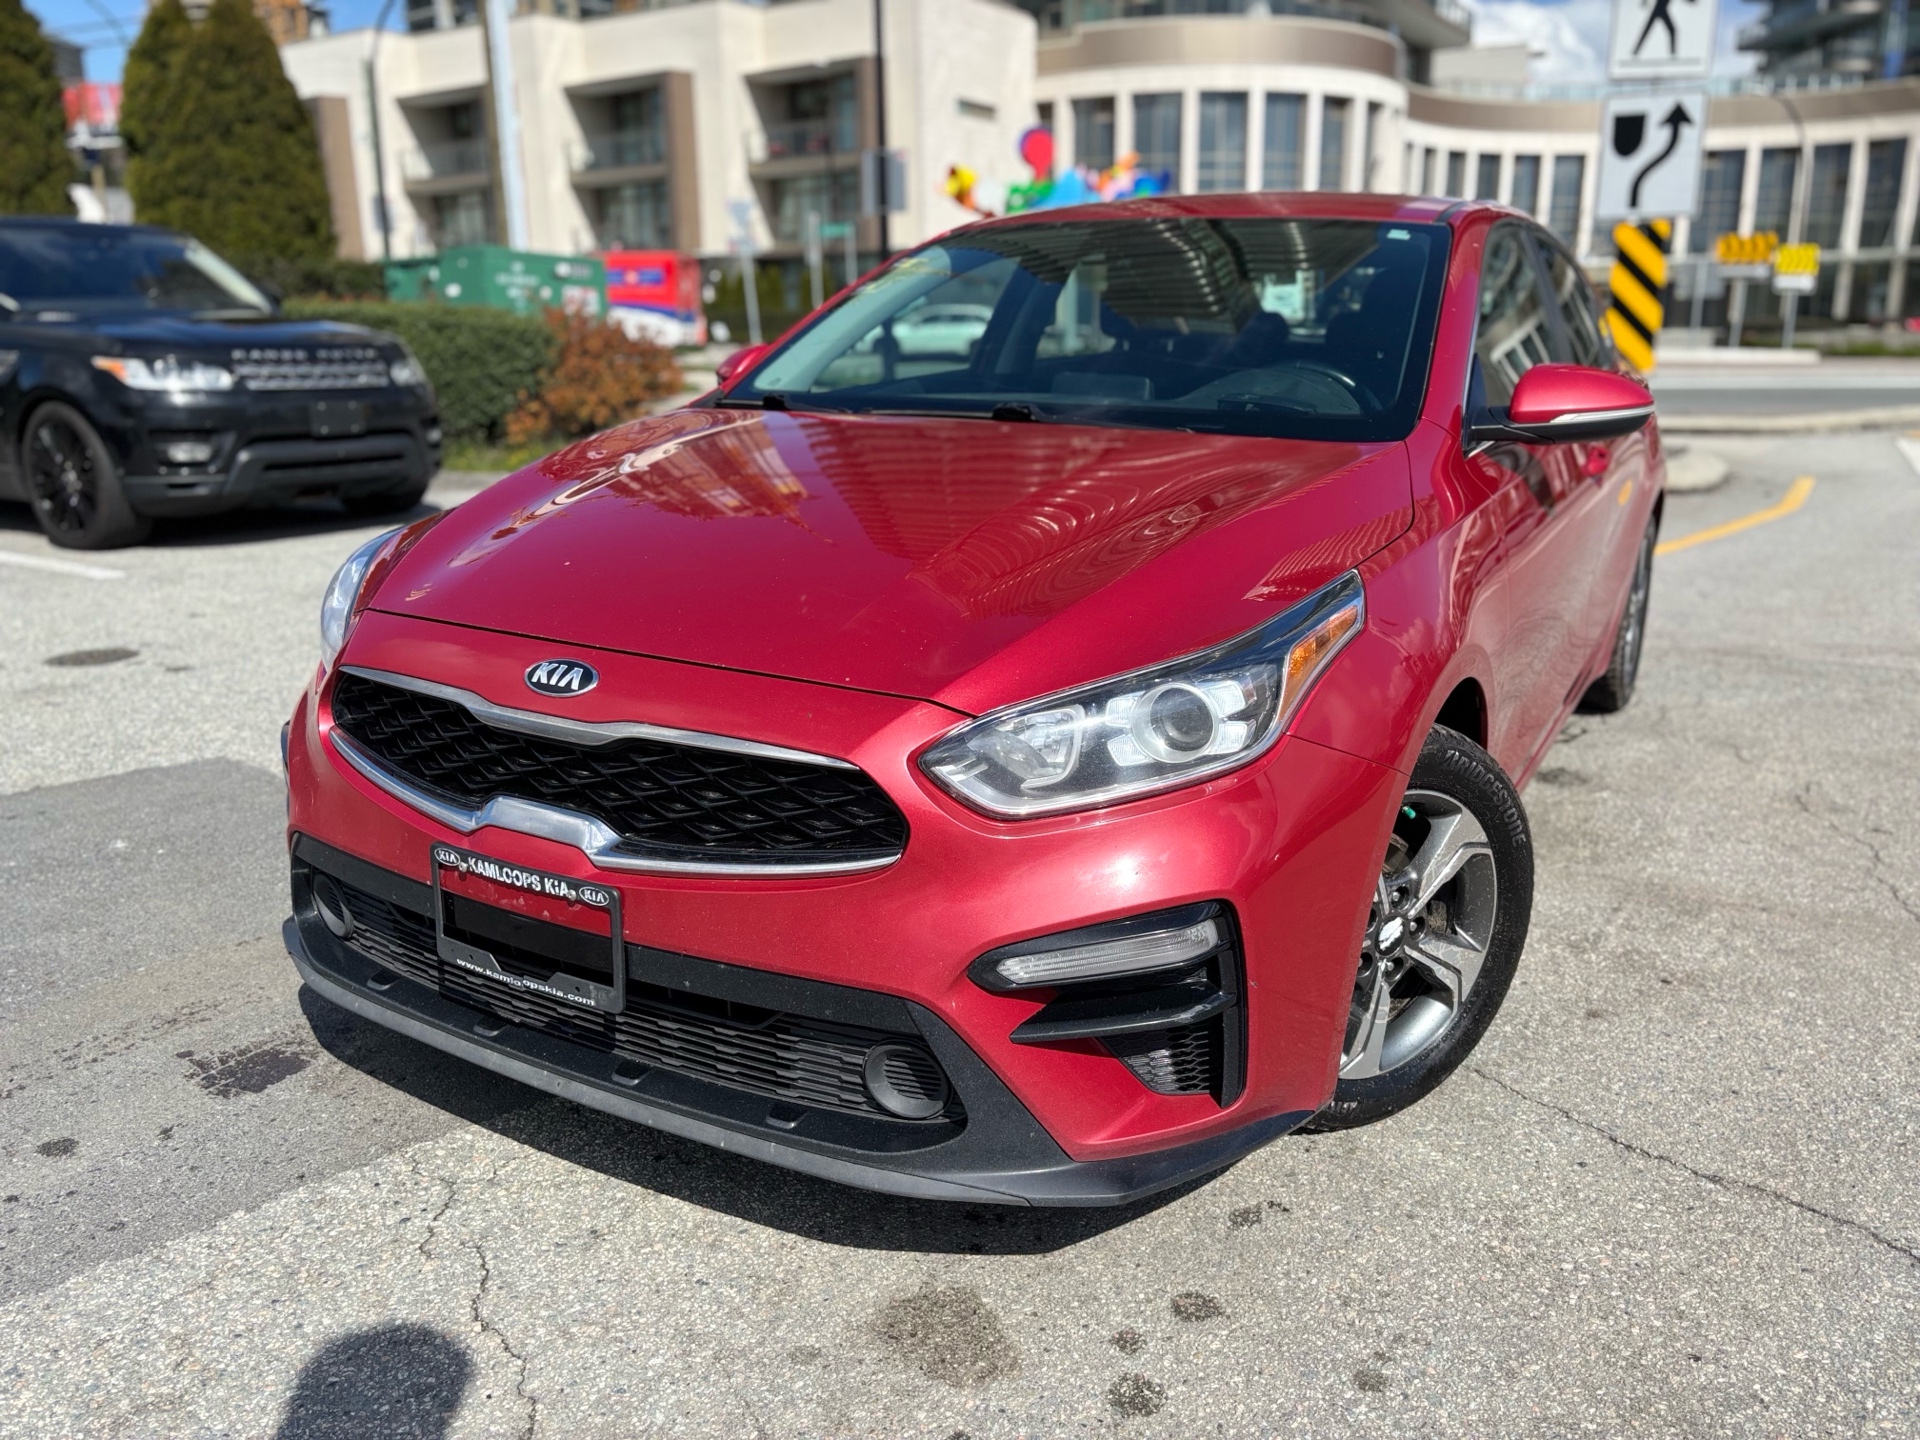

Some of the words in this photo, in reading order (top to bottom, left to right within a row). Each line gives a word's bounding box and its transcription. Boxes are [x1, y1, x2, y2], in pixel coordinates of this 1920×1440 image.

[530, 662, 584, 691] KIA
[1441, 749, 1527, 847] BRIDGESTONE
[438, 849, 458, 865] KIA
[467, 856, 542, 892] KAMLOOPS
[583, 888, 606, 904] KIA
